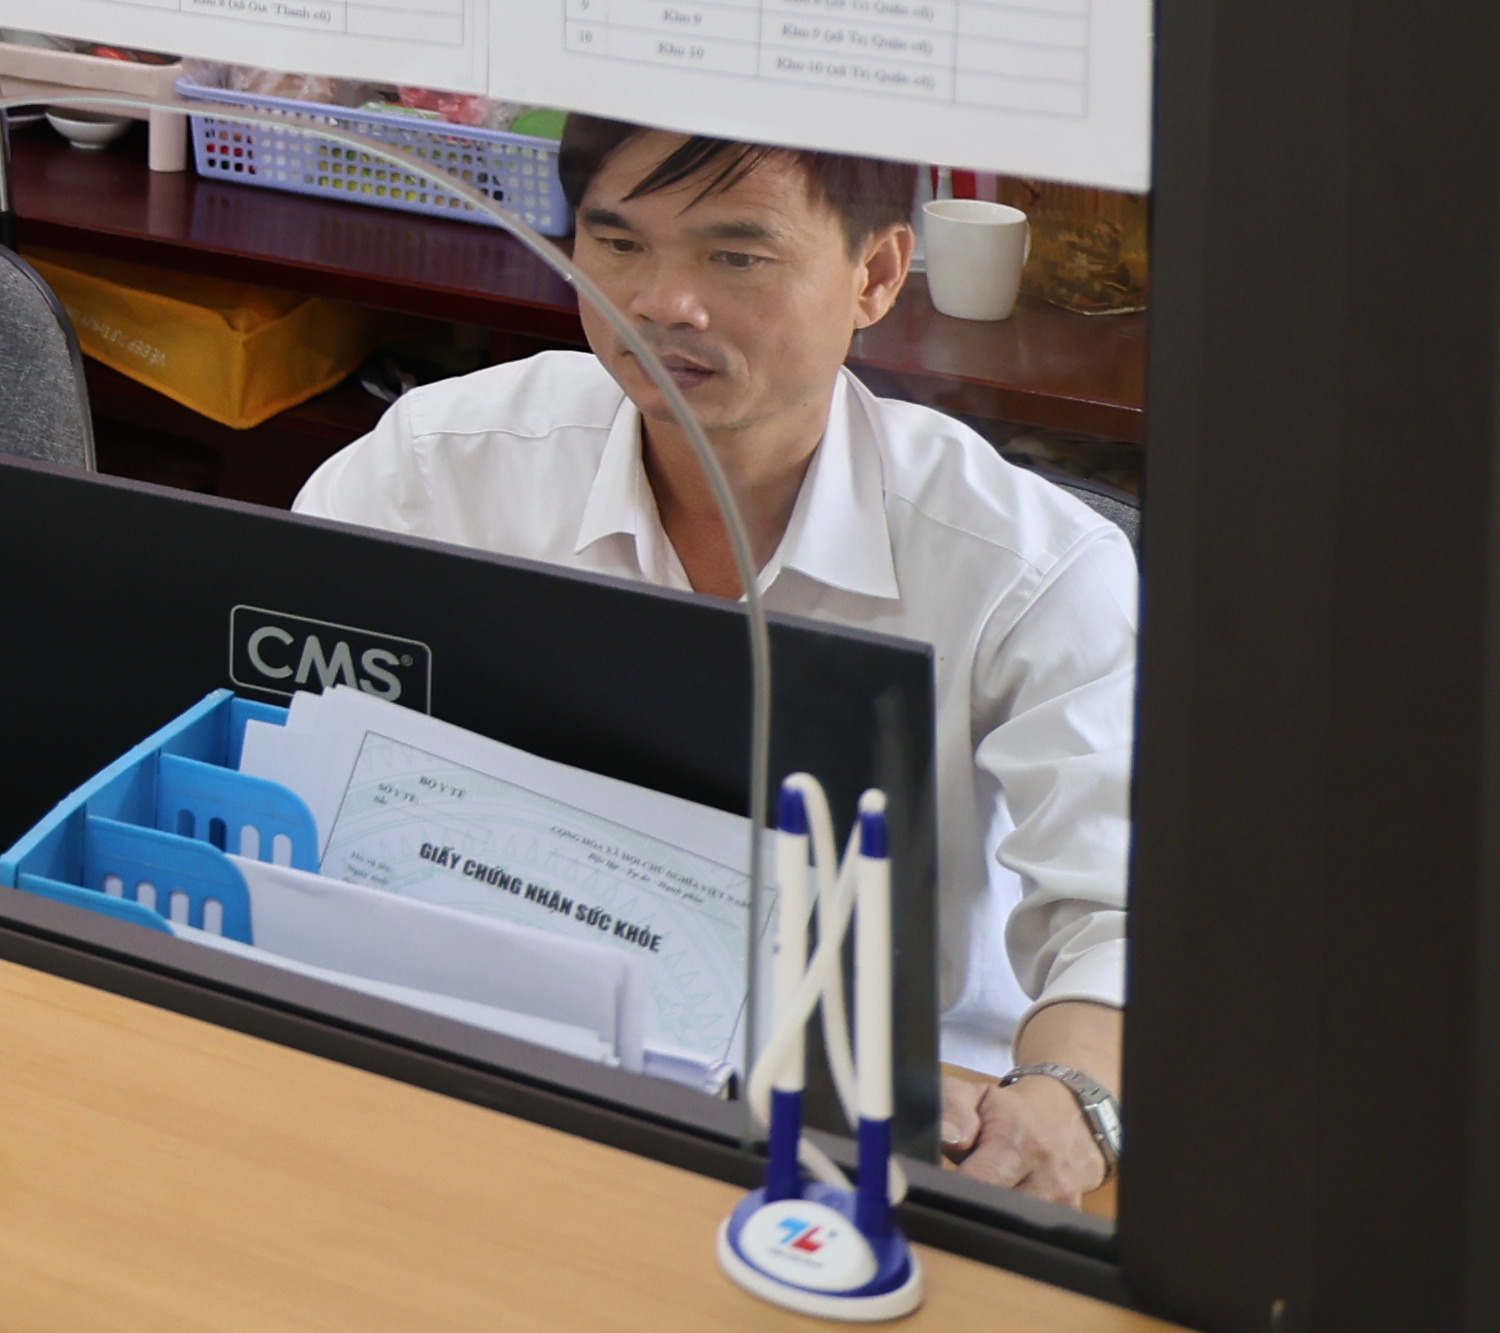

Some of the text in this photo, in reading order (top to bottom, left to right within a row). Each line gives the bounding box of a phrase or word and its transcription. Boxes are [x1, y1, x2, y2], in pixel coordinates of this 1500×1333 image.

[248, 626, 402, 702] CMS
[419, 842, 462, 870] GIẤY
[462, 860, 523, 896] CHỨNG
[524, 881, 575, 916] NHẬN
[574, 905, 613, 933] SỨC
[612, 924, 664, 953] KHỎE
